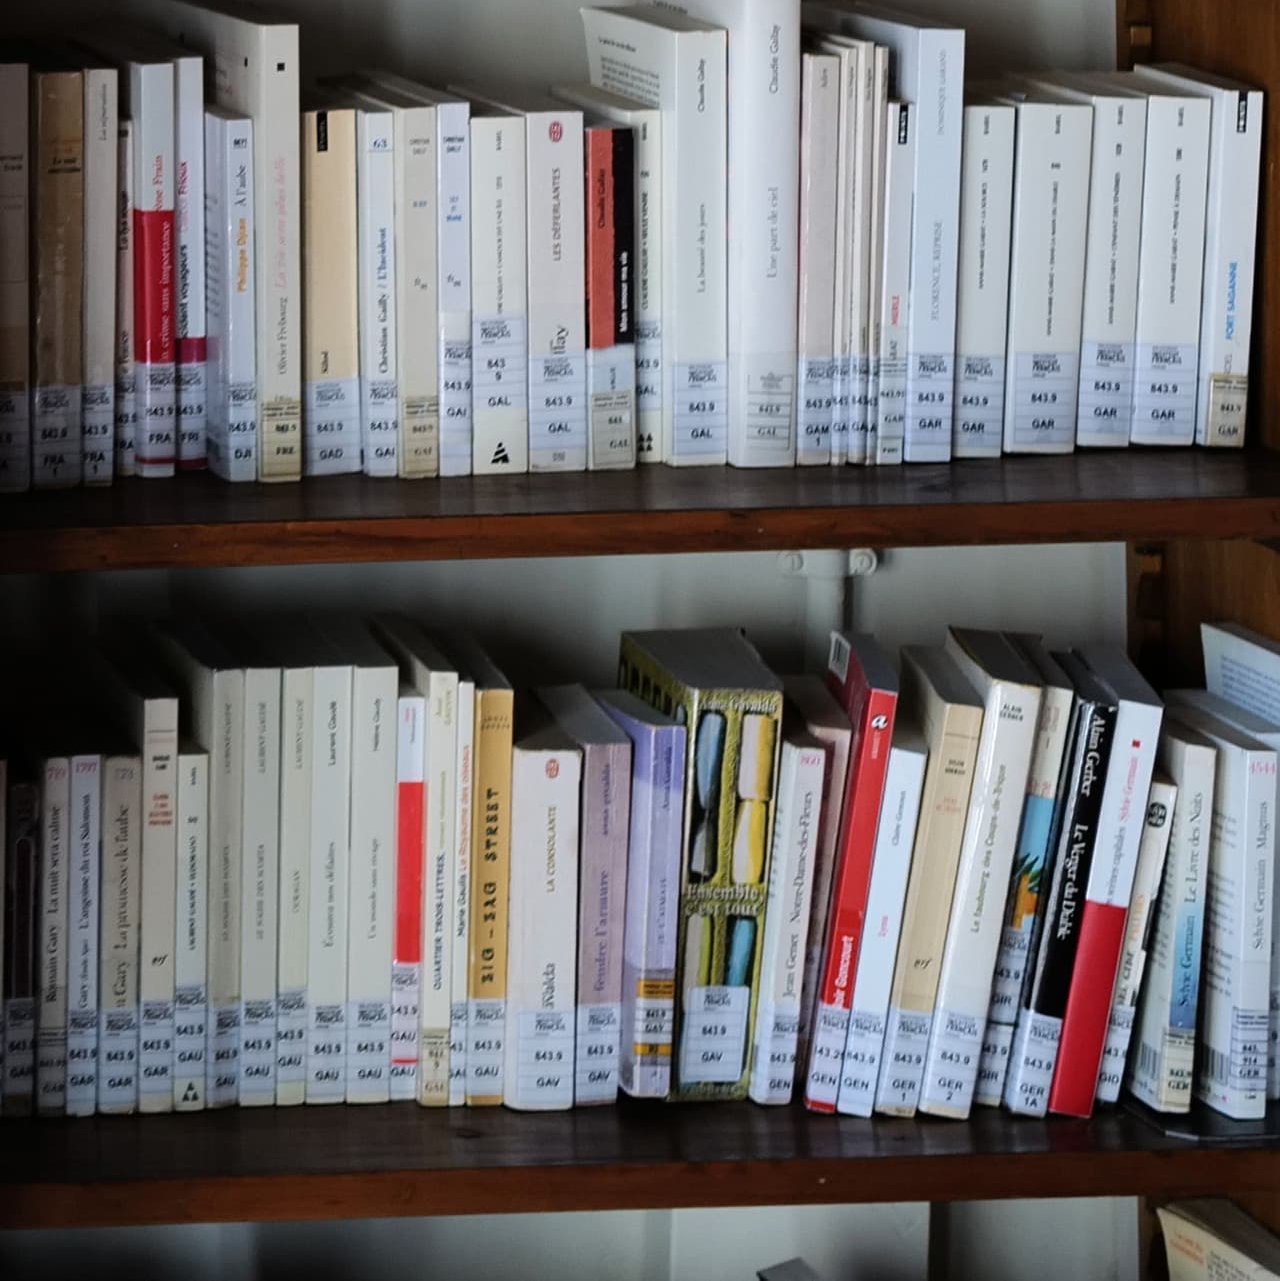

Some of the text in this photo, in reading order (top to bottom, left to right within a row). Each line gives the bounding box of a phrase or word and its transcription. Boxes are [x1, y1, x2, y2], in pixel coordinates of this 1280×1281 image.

[550, 168, 560, 261] LES DÉFERLANTES
[767, 187, 780, 278] Une part de ciel
[1151, 384, 1177, 394] 843.9
[1151, 409, 1174, 419] GAR
[1081, 715, 1106, 797] Alain Gerber
[1187, 792, 1203, 824] Nuits
[1255, 802, 1268, 849] Magnus
[546, 806, 556, 893] LA CONSOLANTE
[1074, 823, 1088, 841] Le
[1187, 828, 1201, 848] des
[1065, 842, 1085, 880] Verger
[1183, 852, 1200, 885] Livre
[783, 791, 813, 999] Jean Genet Notre-Dame-des-Fleurs
[1183, 888, 1197, 903] Le
[1253, 859, 1266, 913] Germain
[1178, 915, 1195, 968] Germain
